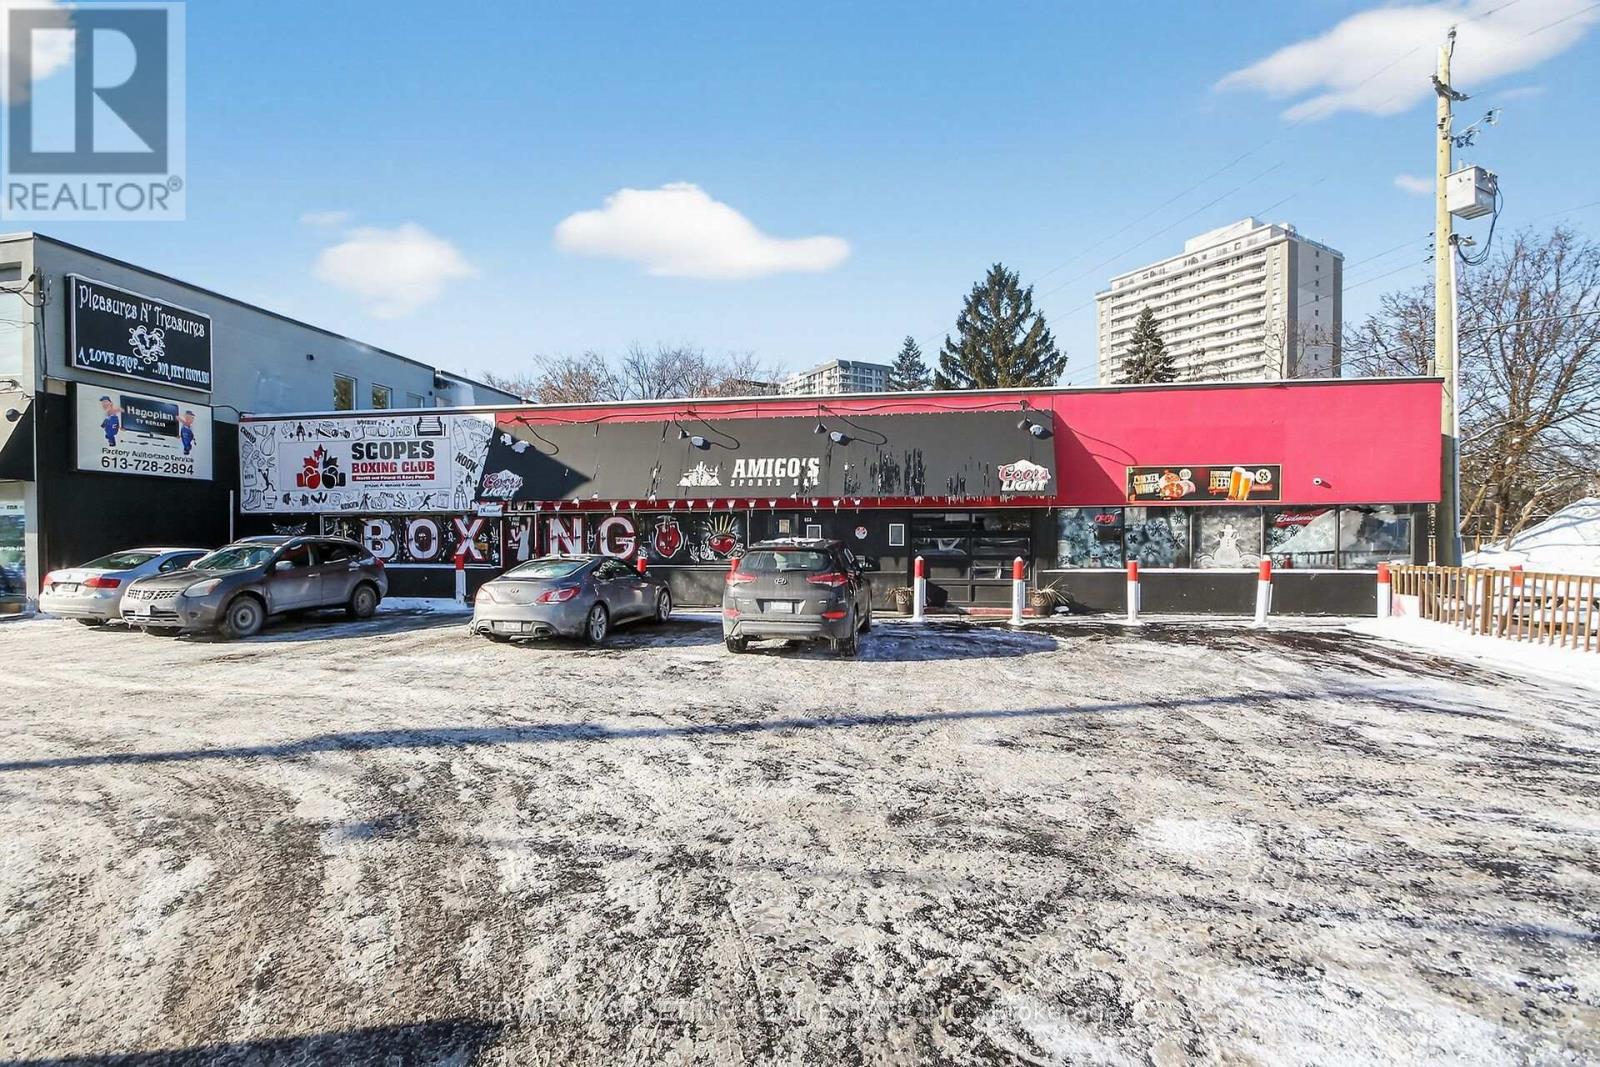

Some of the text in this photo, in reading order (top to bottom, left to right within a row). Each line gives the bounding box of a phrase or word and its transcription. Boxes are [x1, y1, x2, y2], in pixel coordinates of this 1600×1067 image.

[79, 285, 138, 320] Pleasures
[154, 306, 205, 337] Treasures
[89, 348, 115, 364] LOVE
[127, 406, 174, 421] Hagopian
[102, 447, 130, 457] Factory
[351, 440, 435, 460] SCOPES
[101, 456, 194, 475] 613-728-2894
[351, 460, 435, 474] BOXING CLUB
[455, 452, 479, 474] HOOK
[732, 457, 821, 478] AMIGO'S
[999, 464, 1050, 481] Coors
[730, 478, 781, 487] SPORTS
[1001, 479, 1048, 492] LIGHT
